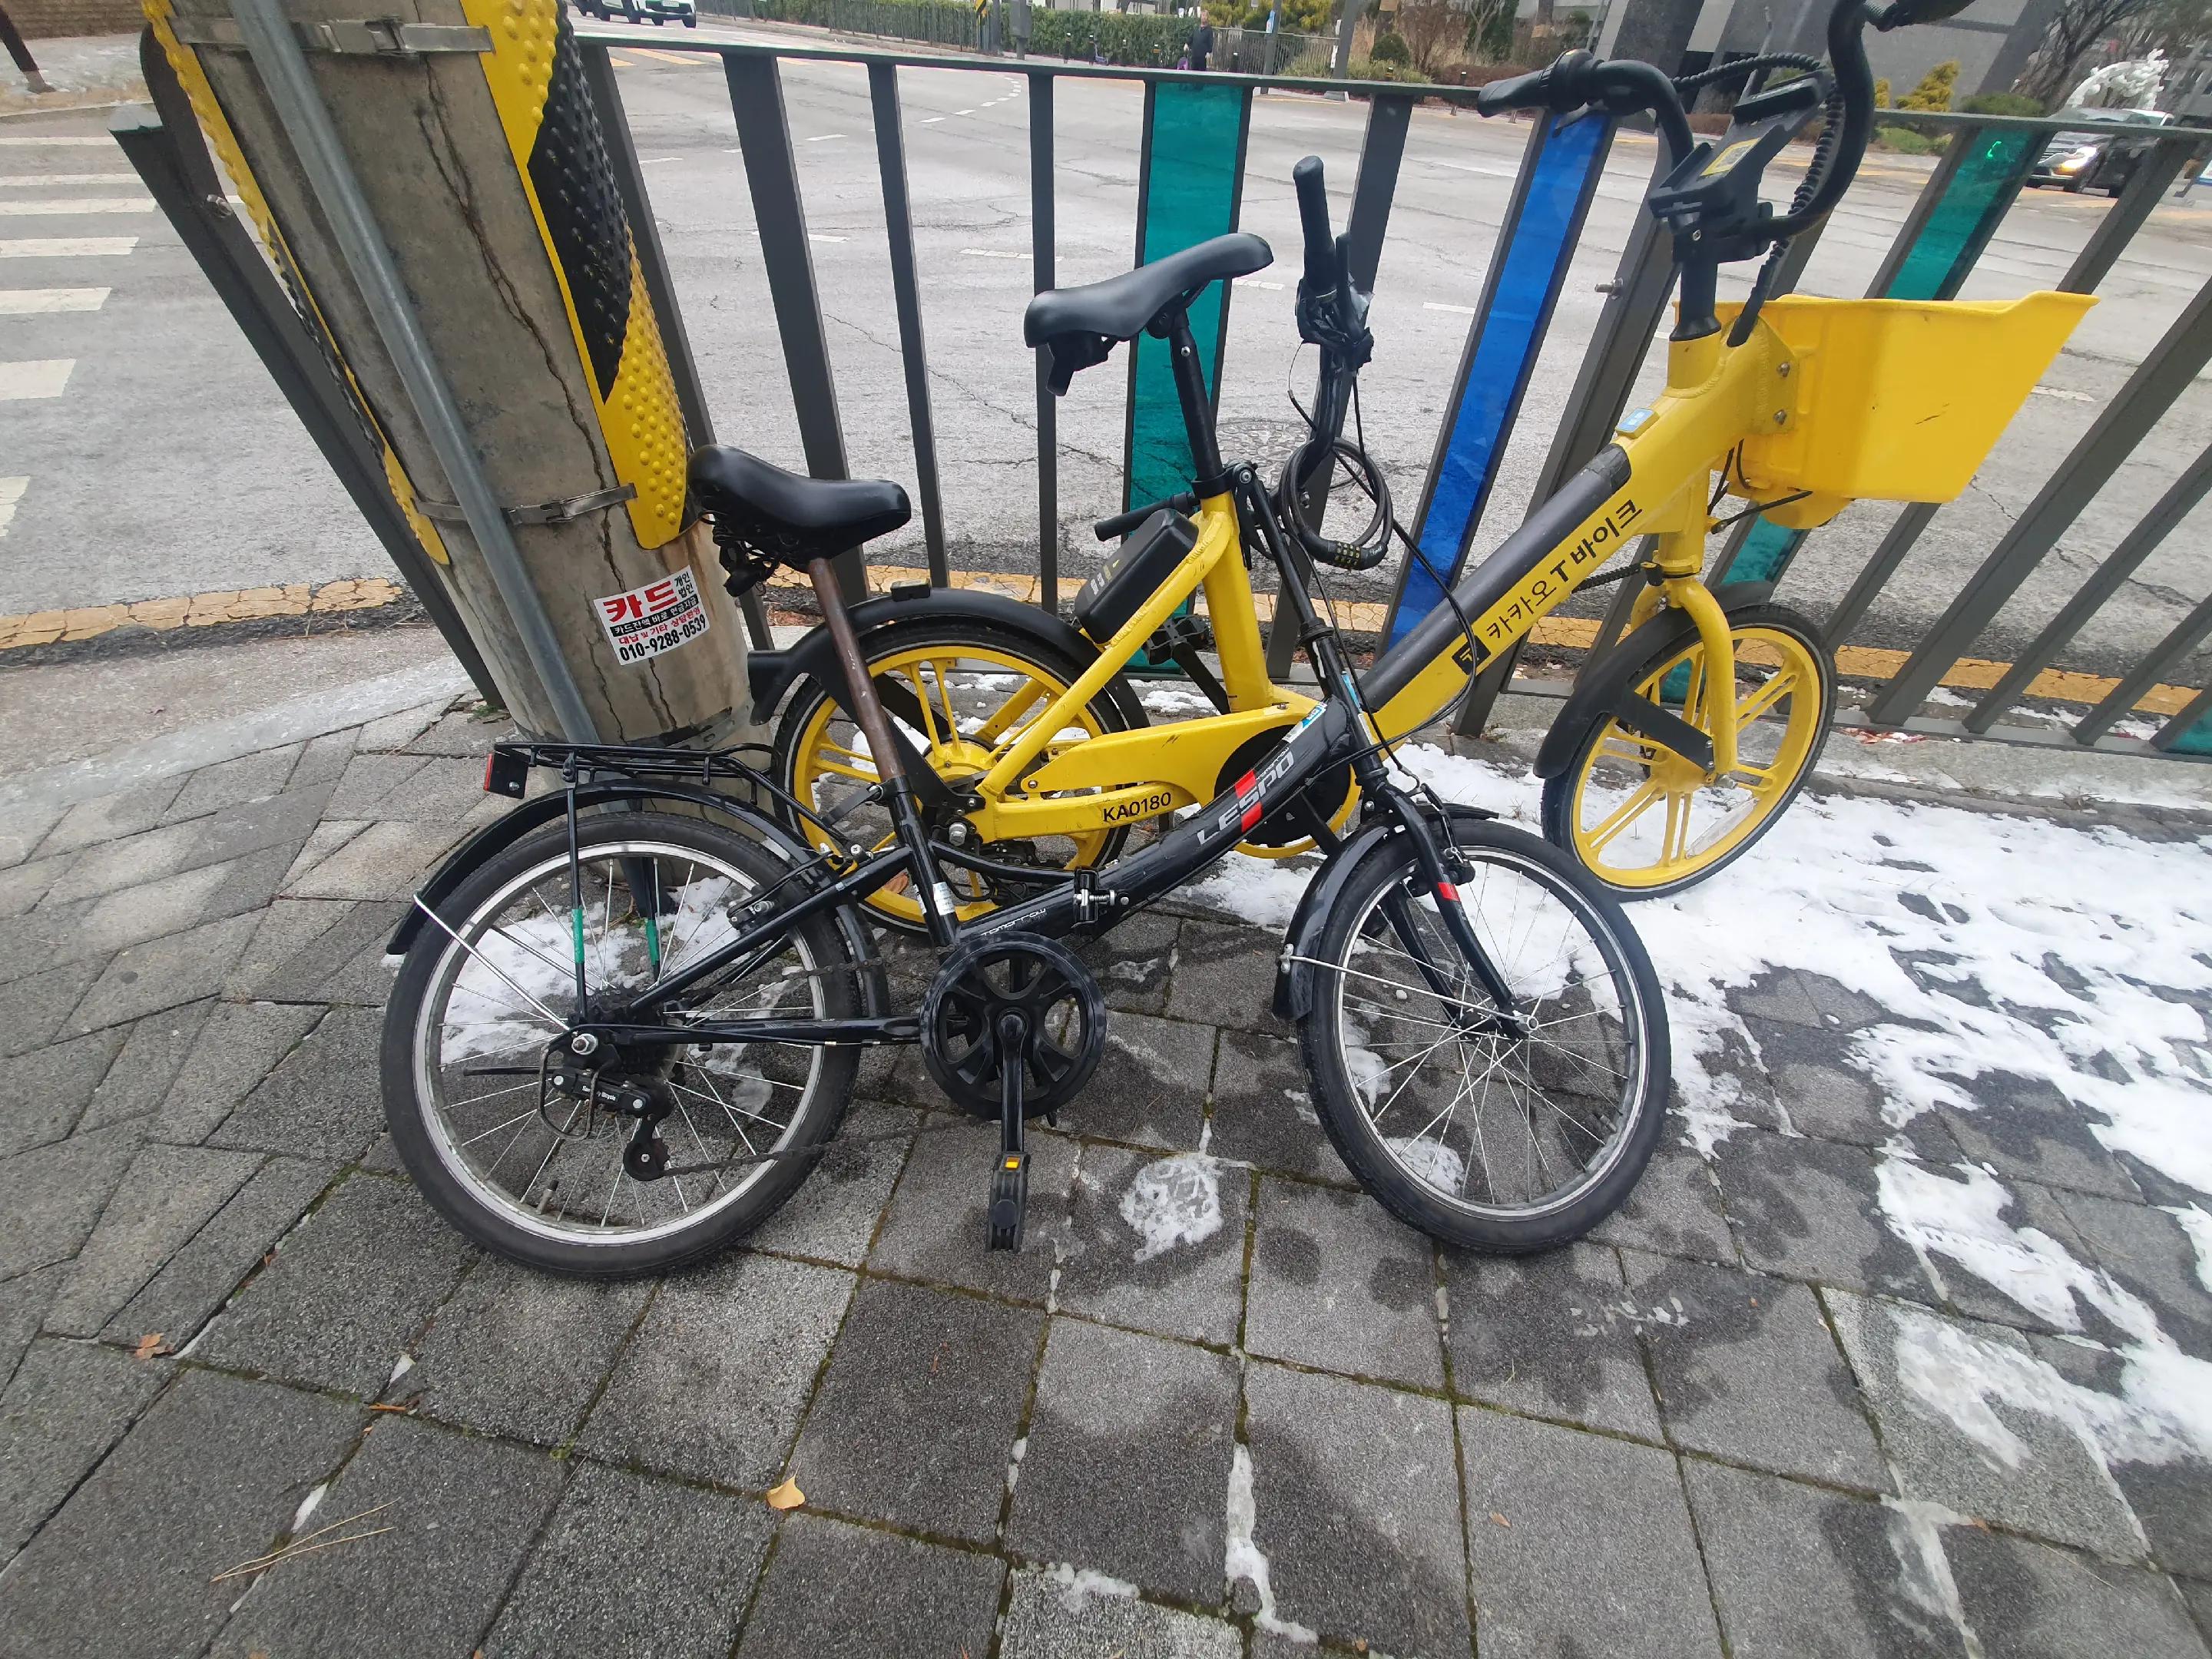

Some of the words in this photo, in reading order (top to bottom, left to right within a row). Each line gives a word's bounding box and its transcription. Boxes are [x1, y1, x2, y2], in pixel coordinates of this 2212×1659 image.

[674, 571, 691, 588] 개인
[677, 583, 694, 599] 법인
[603, 580, 679, 623] 카드
[652, 611, 668, 624] 바로
[670, 595, 699, 616] 현금지급
[618, 633, 640, 645] 대납
[651, 622, 669, 636] 기타
[618, 614, 707, 662] 010-9288-0539
[1101, 791, 1172, 823] KA0180
[1196, 750, 1295, 846] LESPO
